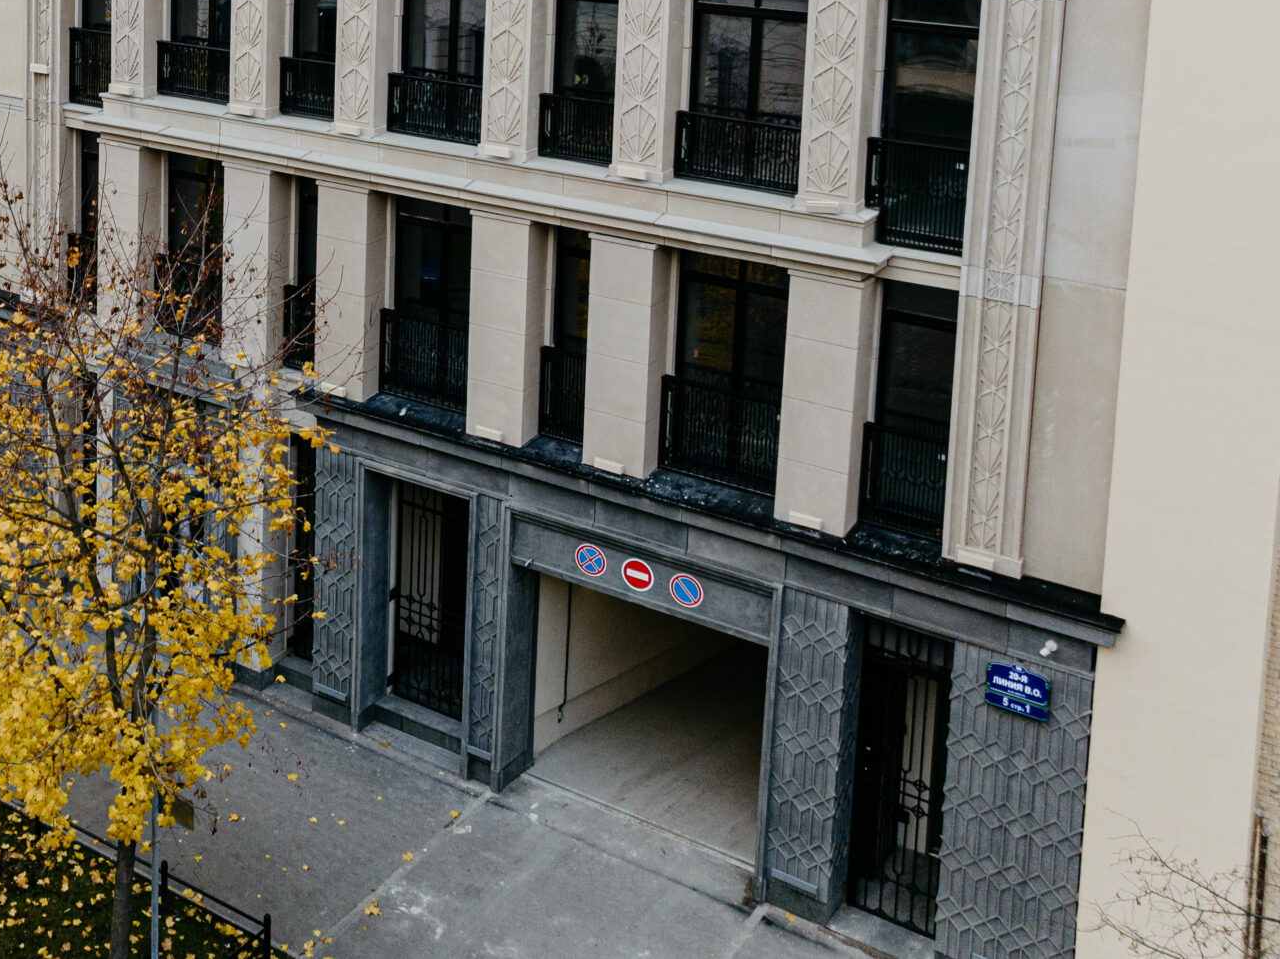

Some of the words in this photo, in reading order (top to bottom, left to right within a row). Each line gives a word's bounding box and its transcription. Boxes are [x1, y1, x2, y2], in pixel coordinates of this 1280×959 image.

[1009, 671, 1028, 683] 20-Я
[993, 676, 1023, 691] ЛИНИЯ
[1024, 686, 1042, 698] В.О.
[1002, 697, 1008, 706] 5
[1010, 703, 1024, 711] стр.
[1025, 704, 1030, 713] 1
